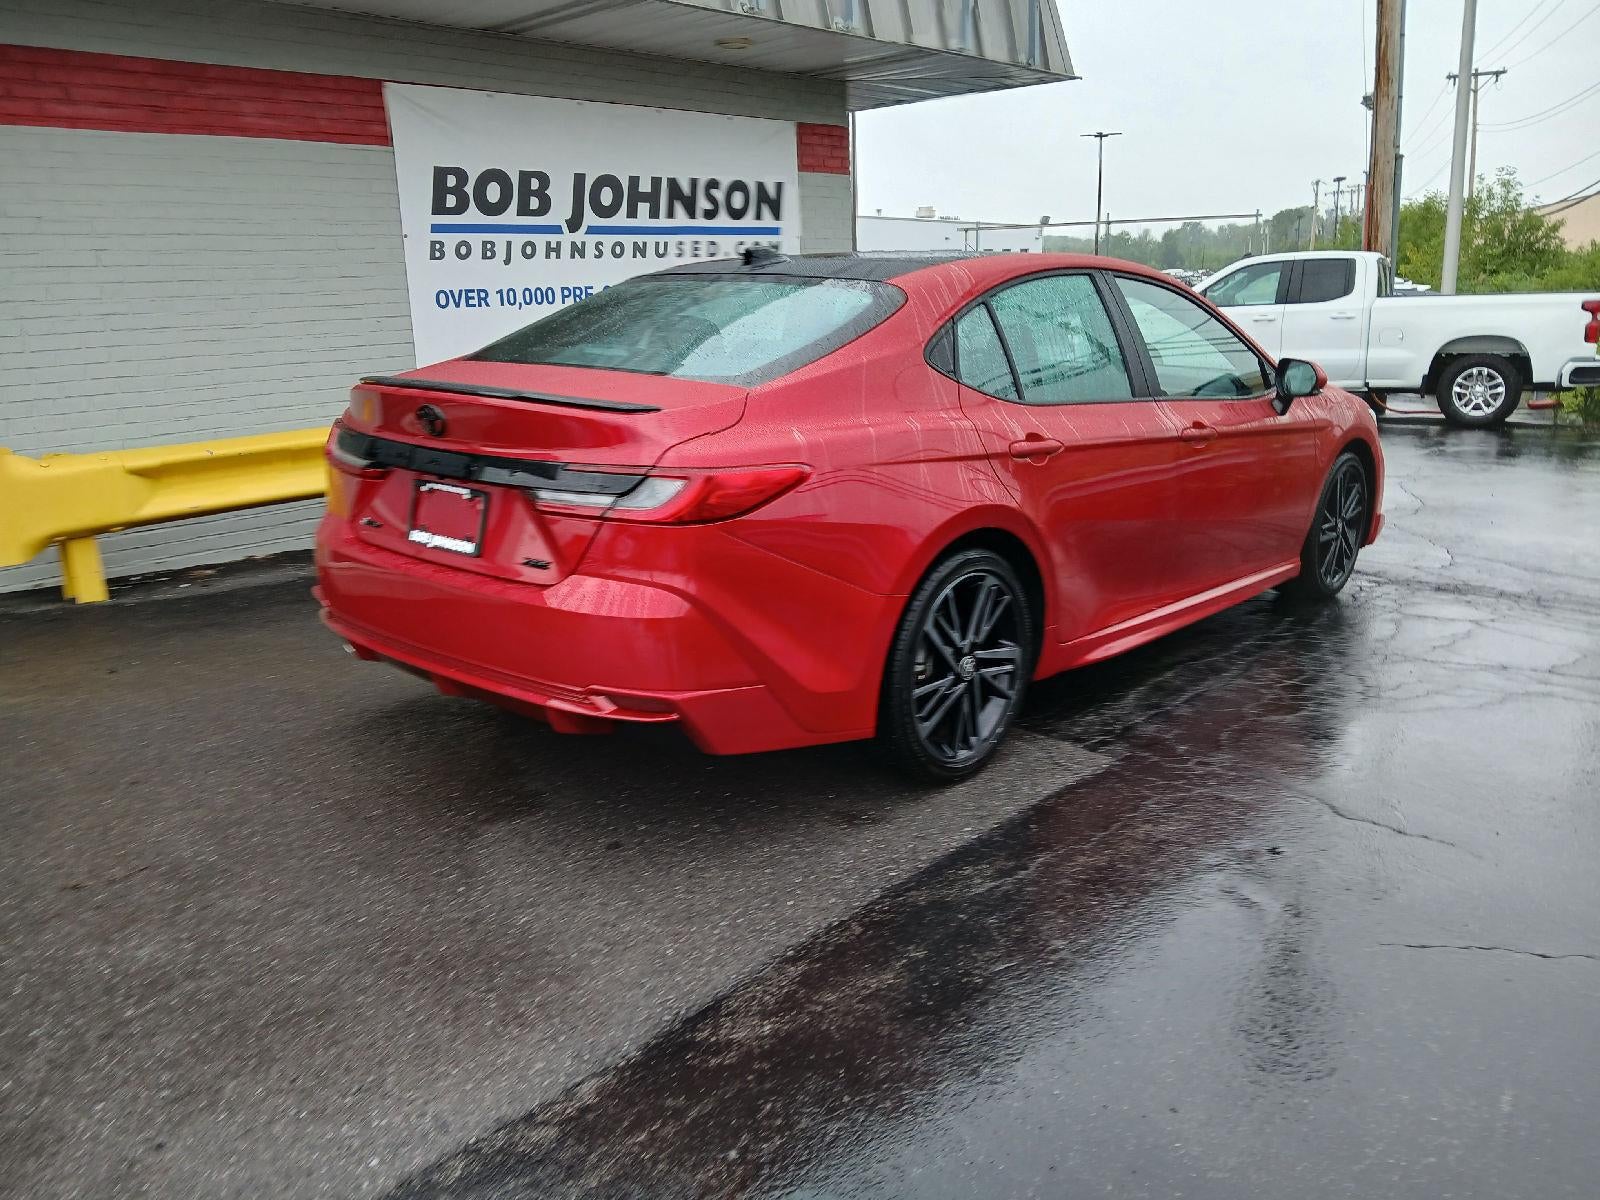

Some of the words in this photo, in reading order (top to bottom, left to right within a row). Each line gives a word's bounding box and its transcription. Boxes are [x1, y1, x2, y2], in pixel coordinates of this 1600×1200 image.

[431, 166, 552, 217] BOB
[564, 172, 785, 234] JOHNSON
[429, 239, 782, 266] BOBJOHNSONUSED.C
[435, 288, 491, 309] OVER
[495, 286, 556, 310] 10,000
